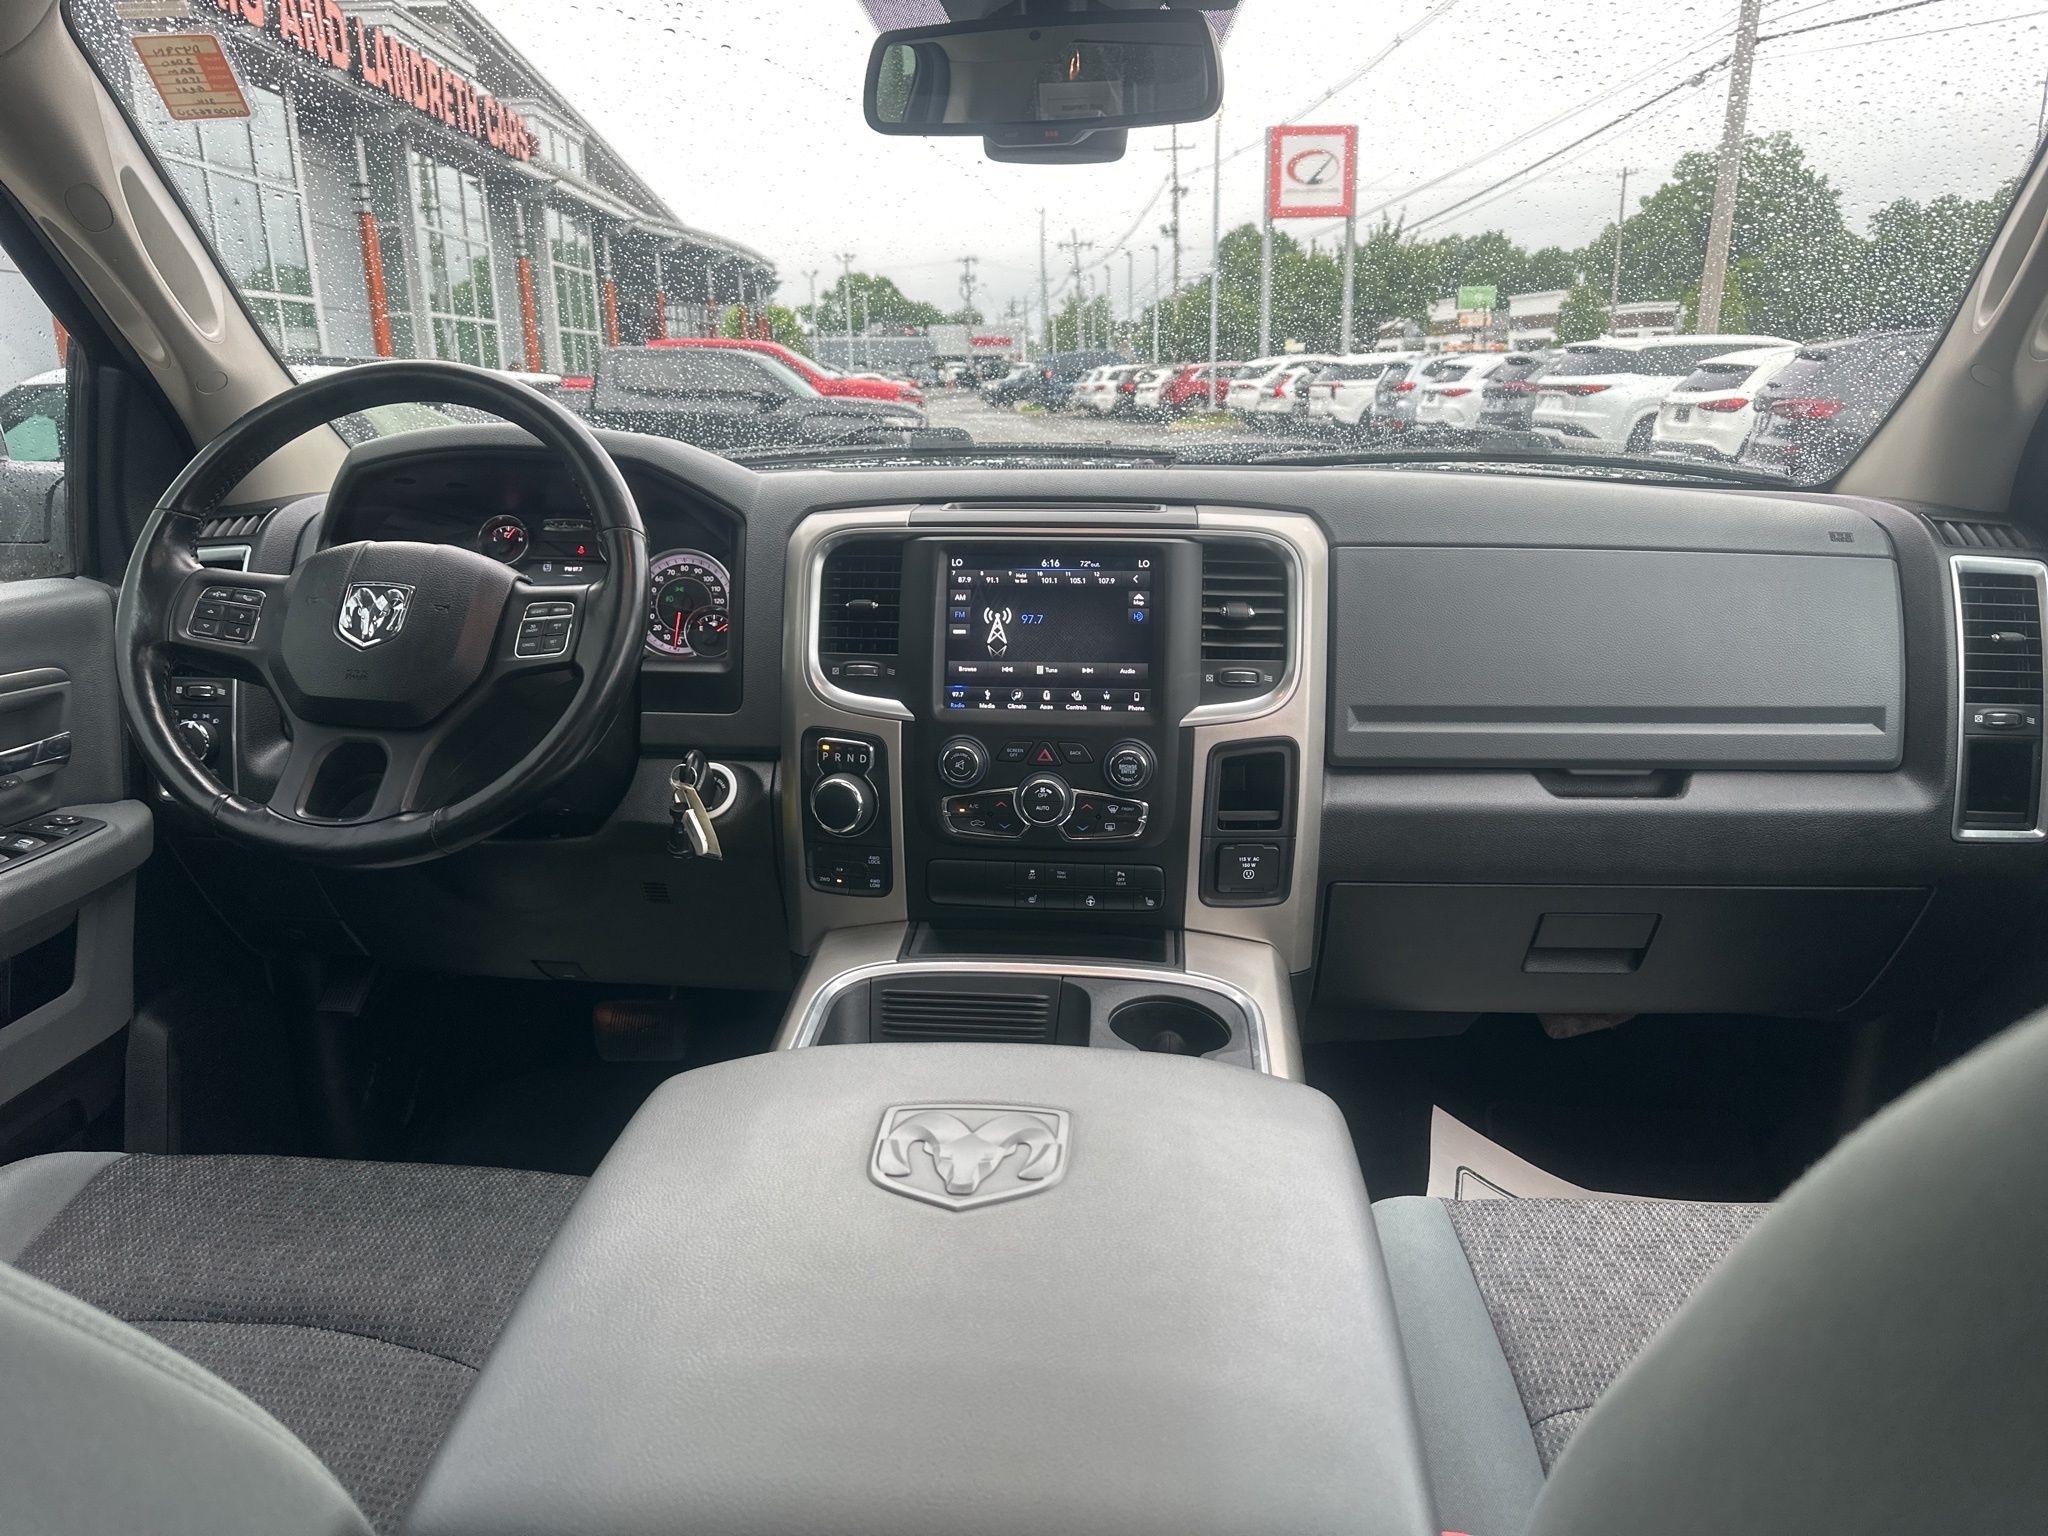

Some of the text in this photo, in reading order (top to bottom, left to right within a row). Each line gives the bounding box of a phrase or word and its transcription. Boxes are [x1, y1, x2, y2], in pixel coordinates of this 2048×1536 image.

[280, 0, 532, 163] AND LANDRETH CARS
[951, 558, 964, 567] LO
[1041, 559, 1060, 568] 6:16
[1138, 560, 1150, 568] LO
[1021, 614, 1044, 624] 97.7
[822, 752, 867, 763] P R N D
